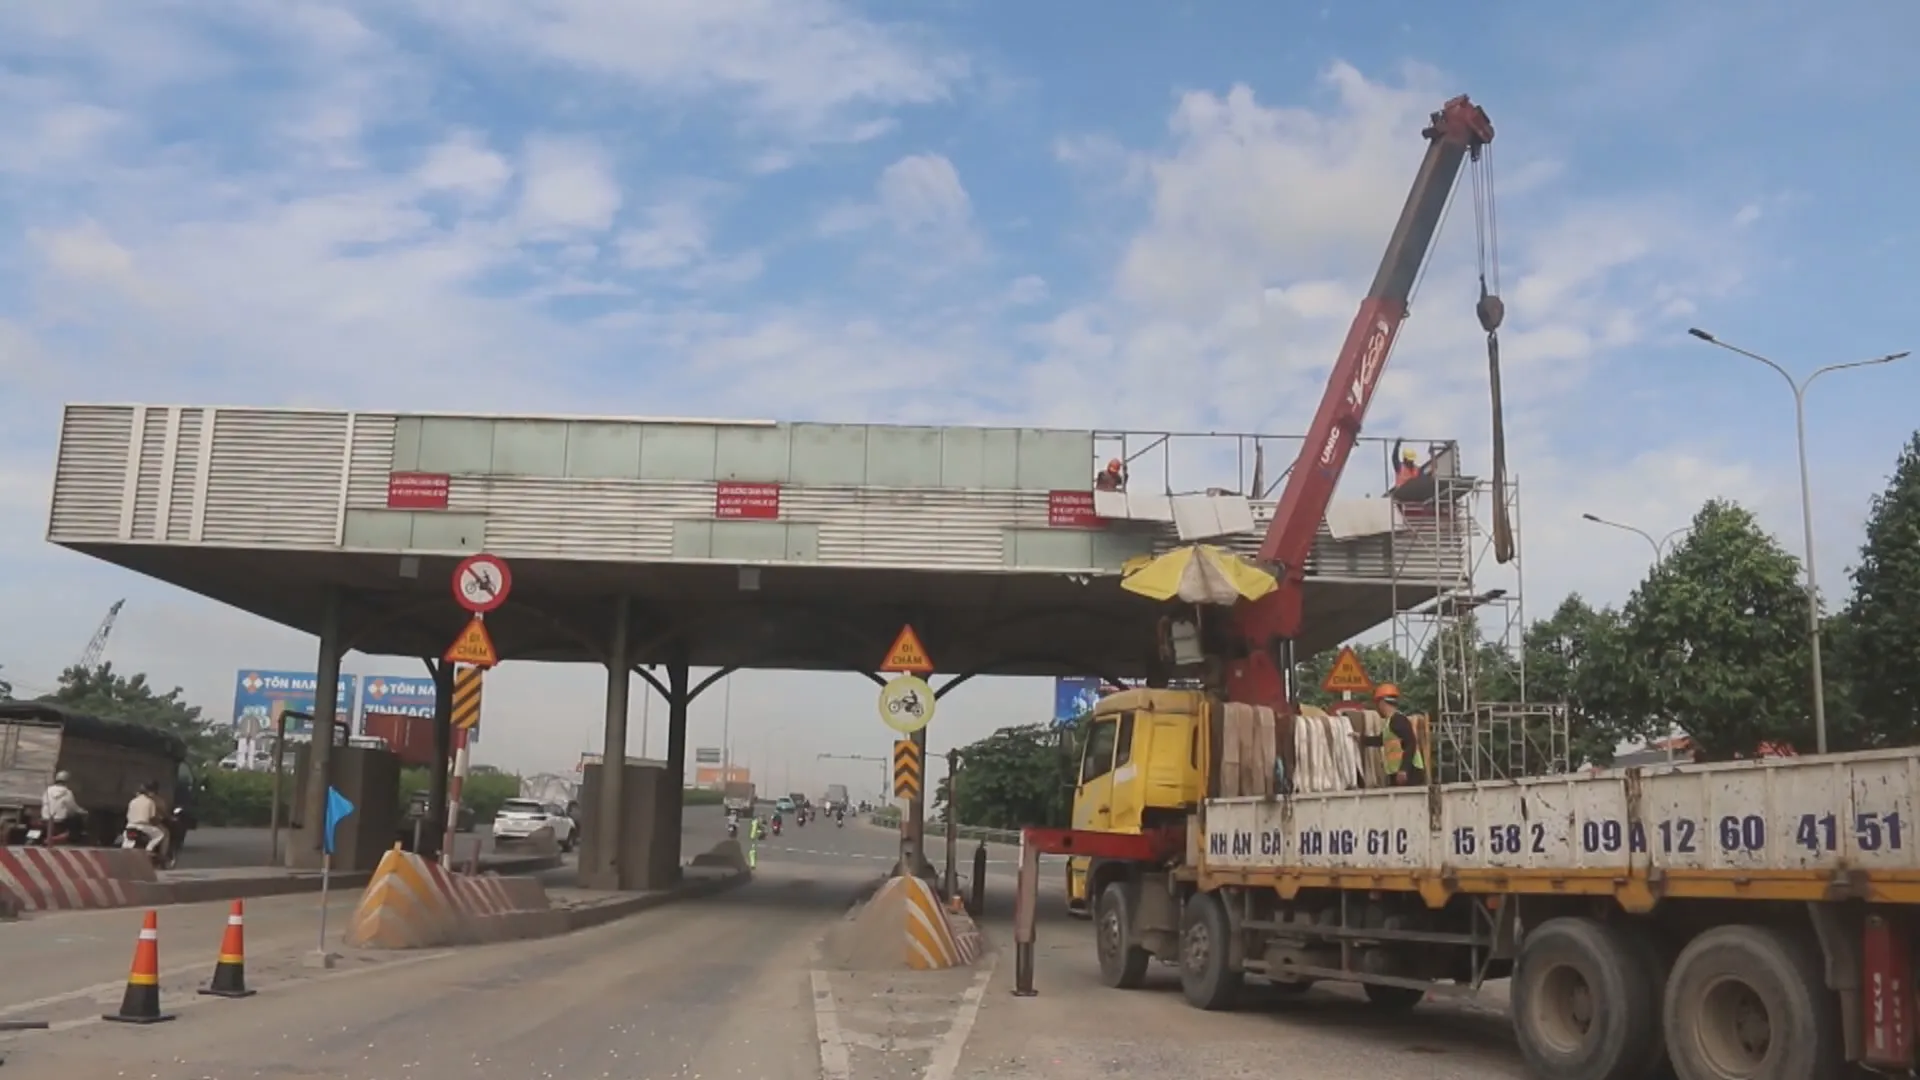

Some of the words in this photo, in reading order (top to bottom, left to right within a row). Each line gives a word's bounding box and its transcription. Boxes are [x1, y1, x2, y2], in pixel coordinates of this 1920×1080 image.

[1321, 425, 1341, 464] UNIC
[264, 675, 289, 688] TÔN
[390, 682, 414, 695] TÔN
[417, 684, 436, 696] NA
